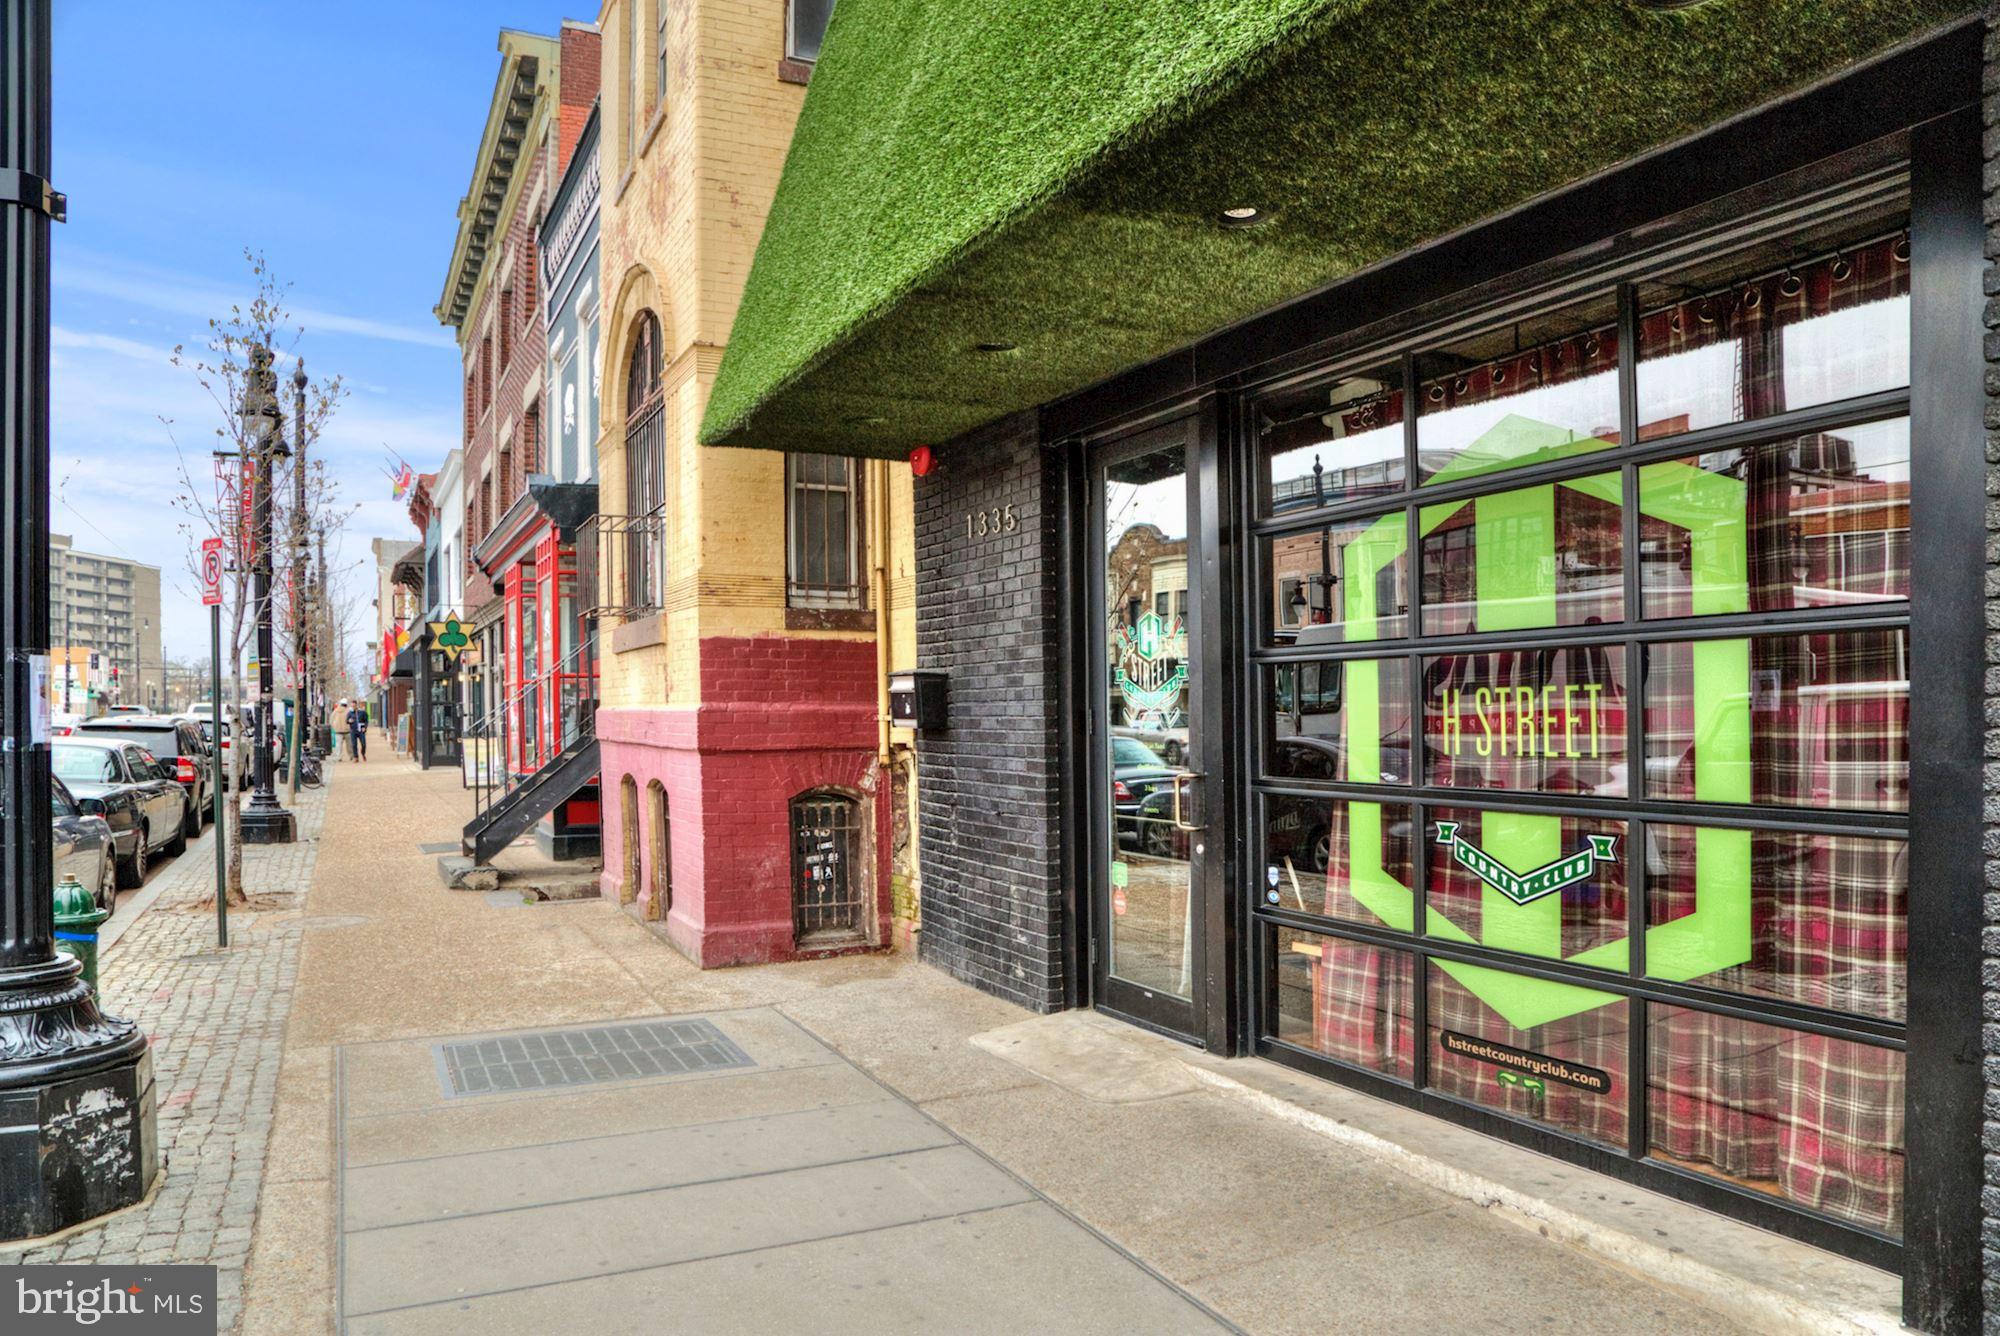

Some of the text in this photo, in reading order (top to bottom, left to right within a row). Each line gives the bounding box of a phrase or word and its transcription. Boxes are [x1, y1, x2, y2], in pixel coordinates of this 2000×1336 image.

[967, 504, 1016, 539] 1335
[1131, 653, 1168, 692] STREET
[1442, 683, 1603, 759] H STREET
[1459, 846, 1586, 896] COUNTRY CLUB
[1448, 1035, 1601, 1088] hstreetcountryclub.com
